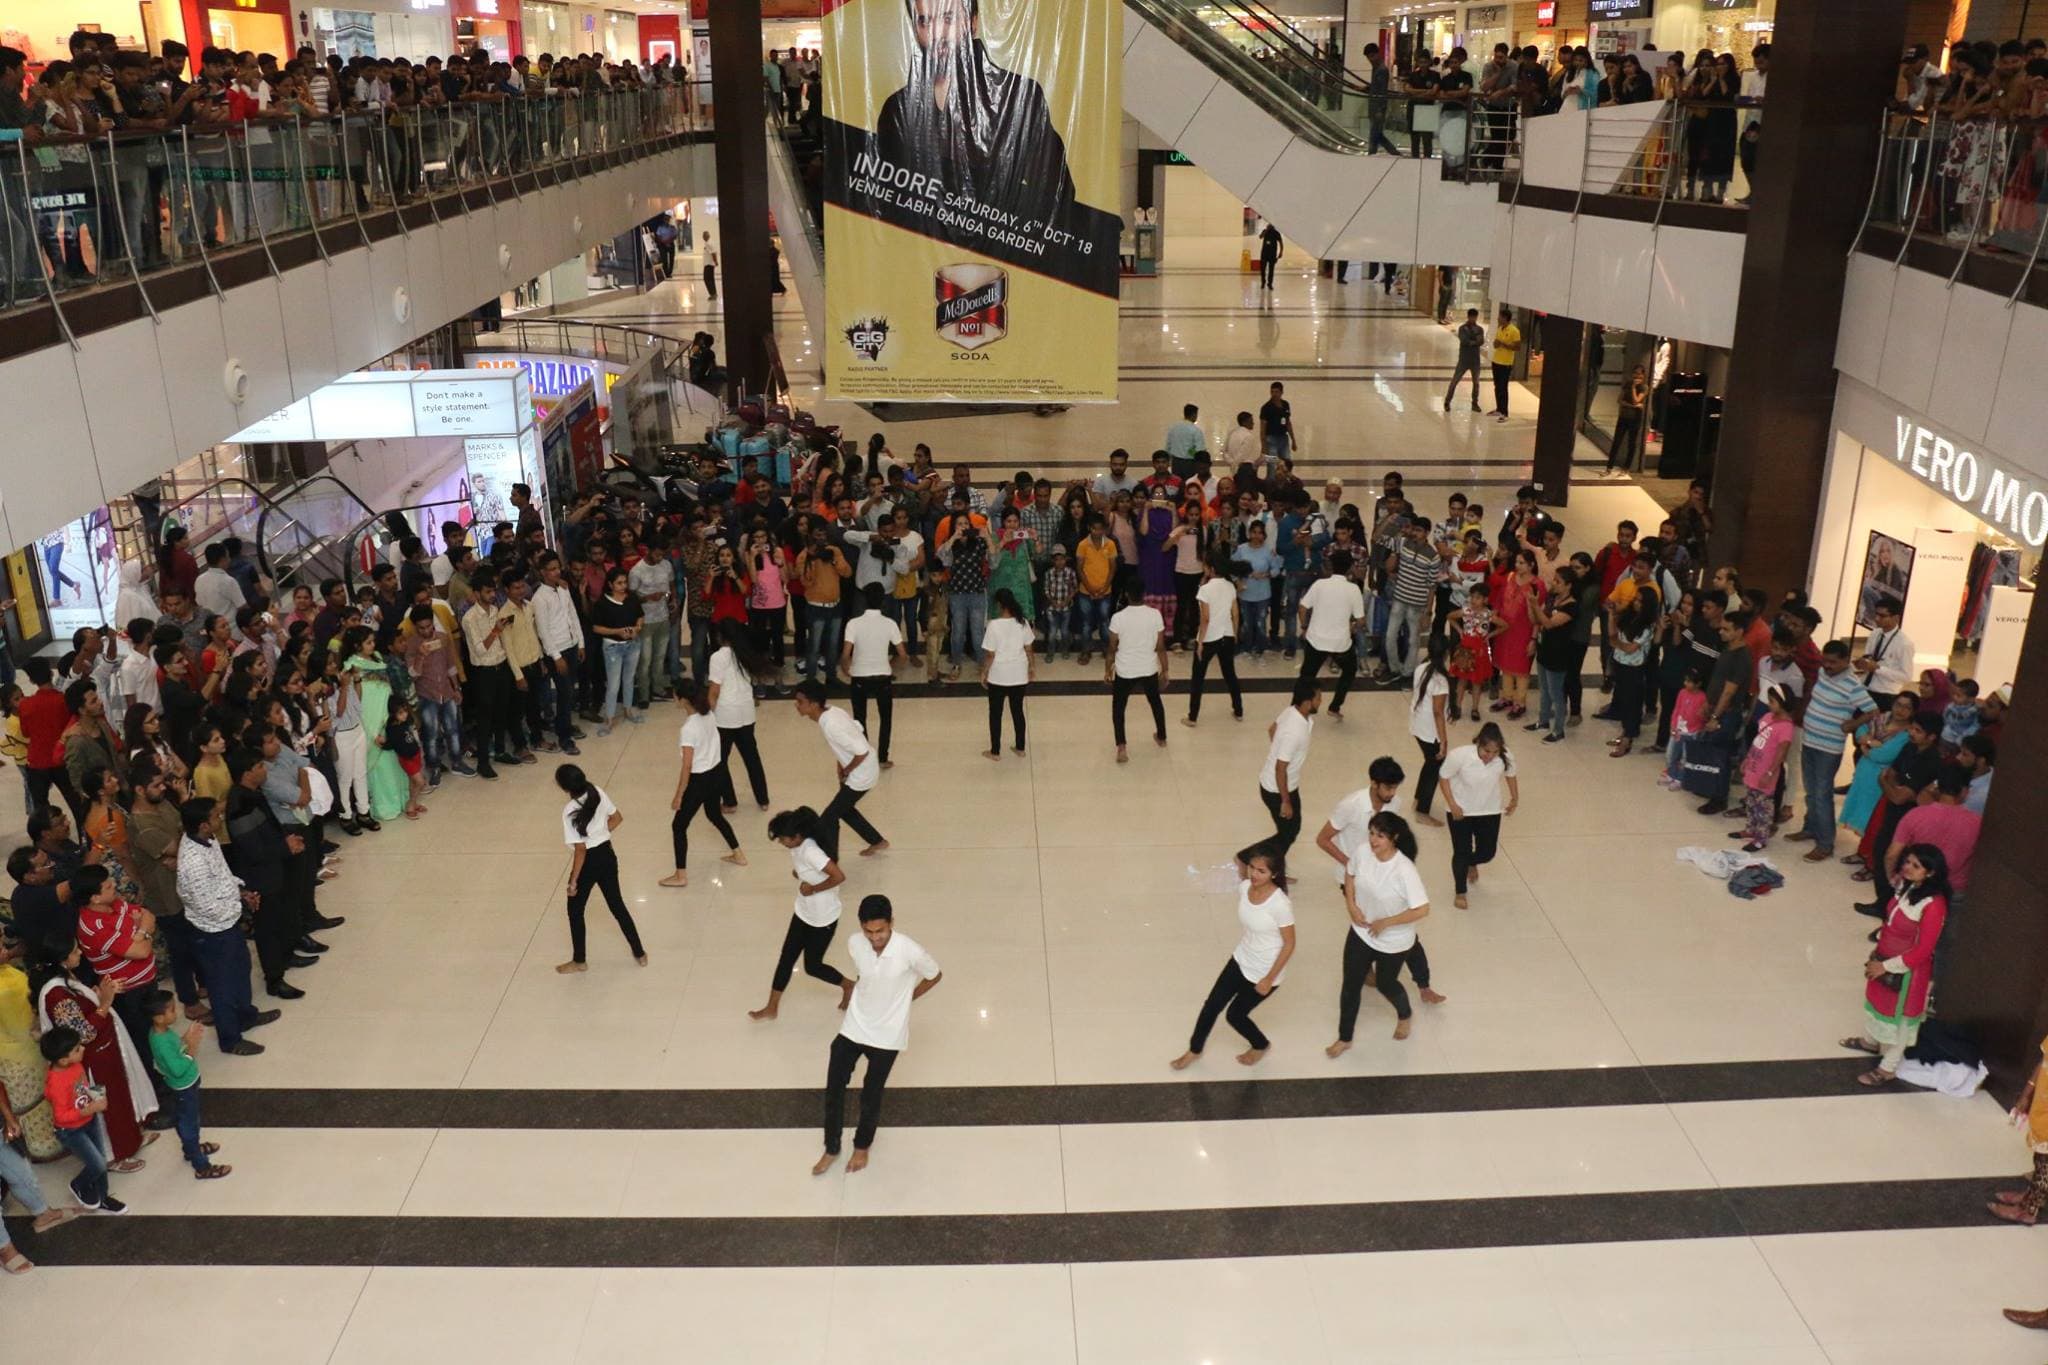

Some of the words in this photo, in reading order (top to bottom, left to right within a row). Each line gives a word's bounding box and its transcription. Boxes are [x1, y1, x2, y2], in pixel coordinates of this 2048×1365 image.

[852, 152, 943, 201] INDORE
[944, 192, 1019, 230] SATURDAY,
[1077, 238, 1093, 255] 18
[848, 175, 893, 203] VENUE
[896, 190, 934, 217] LABH
[936, 207, 984, 235] GANGA
[987, 226, 1045, 257] GARDEN
[853, 342, 886, 351] CITY
[950, 352, 990, 361] SODA
[426, 391, 449, 400] Don't
[451, 391, 475, 399] make
[422, 404, 443, 413] style
[446, 403, 491, 411] statement.
[441, 415, 453, 424] Be
[455, 415, 473, 423] one.
[467, 443, 497, 452] MARKS
[467, 452, 507, 461] SPENCER
[1896, 415, 1978, 503] VERO
[1981, 468, 2048, 547] MO
